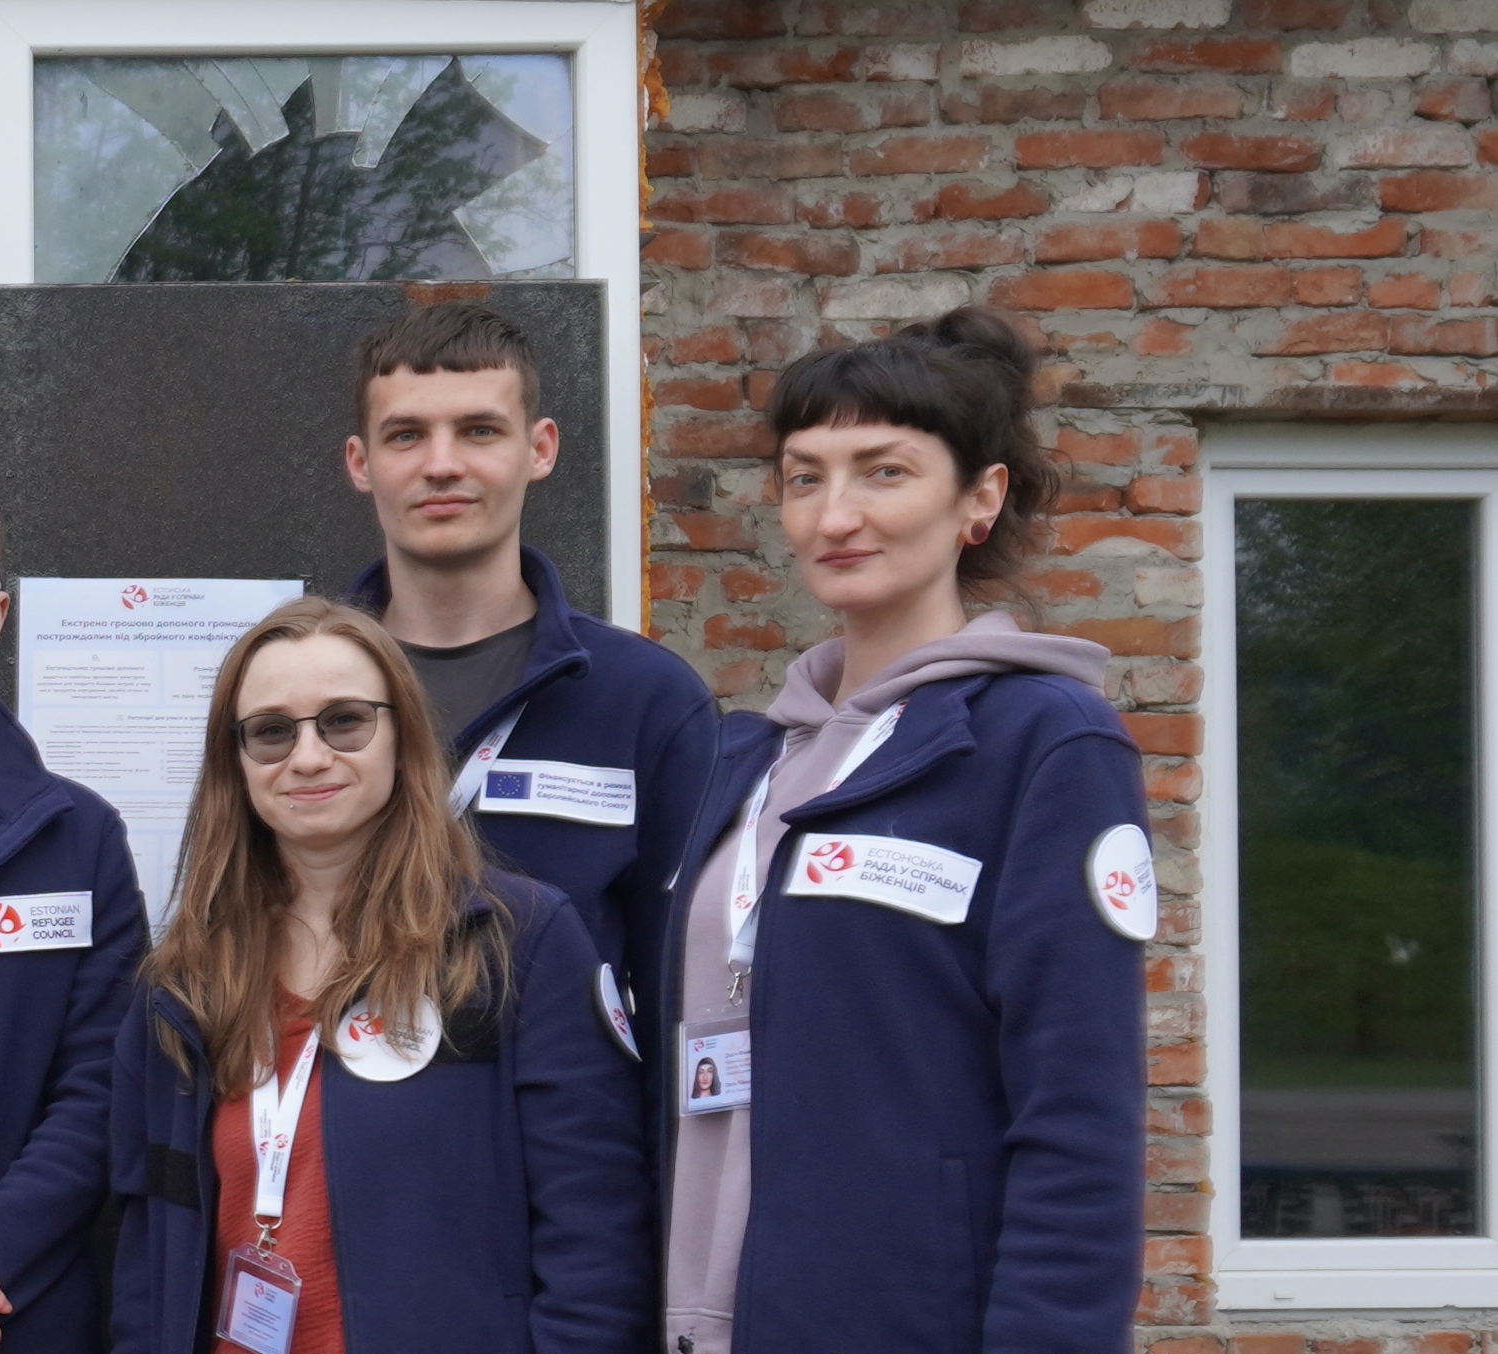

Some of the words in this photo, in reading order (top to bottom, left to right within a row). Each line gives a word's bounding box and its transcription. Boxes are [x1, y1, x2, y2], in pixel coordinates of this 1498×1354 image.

[61, 619, 107, 628] Екстрена
[110, 620, 154, 629] грошова
[156, 620, 205, 628] допомога
[37, 633, 112, 642] постраждалим
[115, 633, 130, 642] від
[133, 632, 185, 642] збройного
[867, 847, 944, 873] ЕСТОНСЬКА
[859, 871, 927, 894] БІЖЕНЦІВ
[863, 859, 897, 873] РАДА
[900, 866, 909, 875] У
[910, 869, 969, 895] СПРАВАХ
[30, 904, 80, 916] ESTONIAN
[31, 917, 76, 928] REFUGEE
[32, 929, 76, 940] COUNCIL
